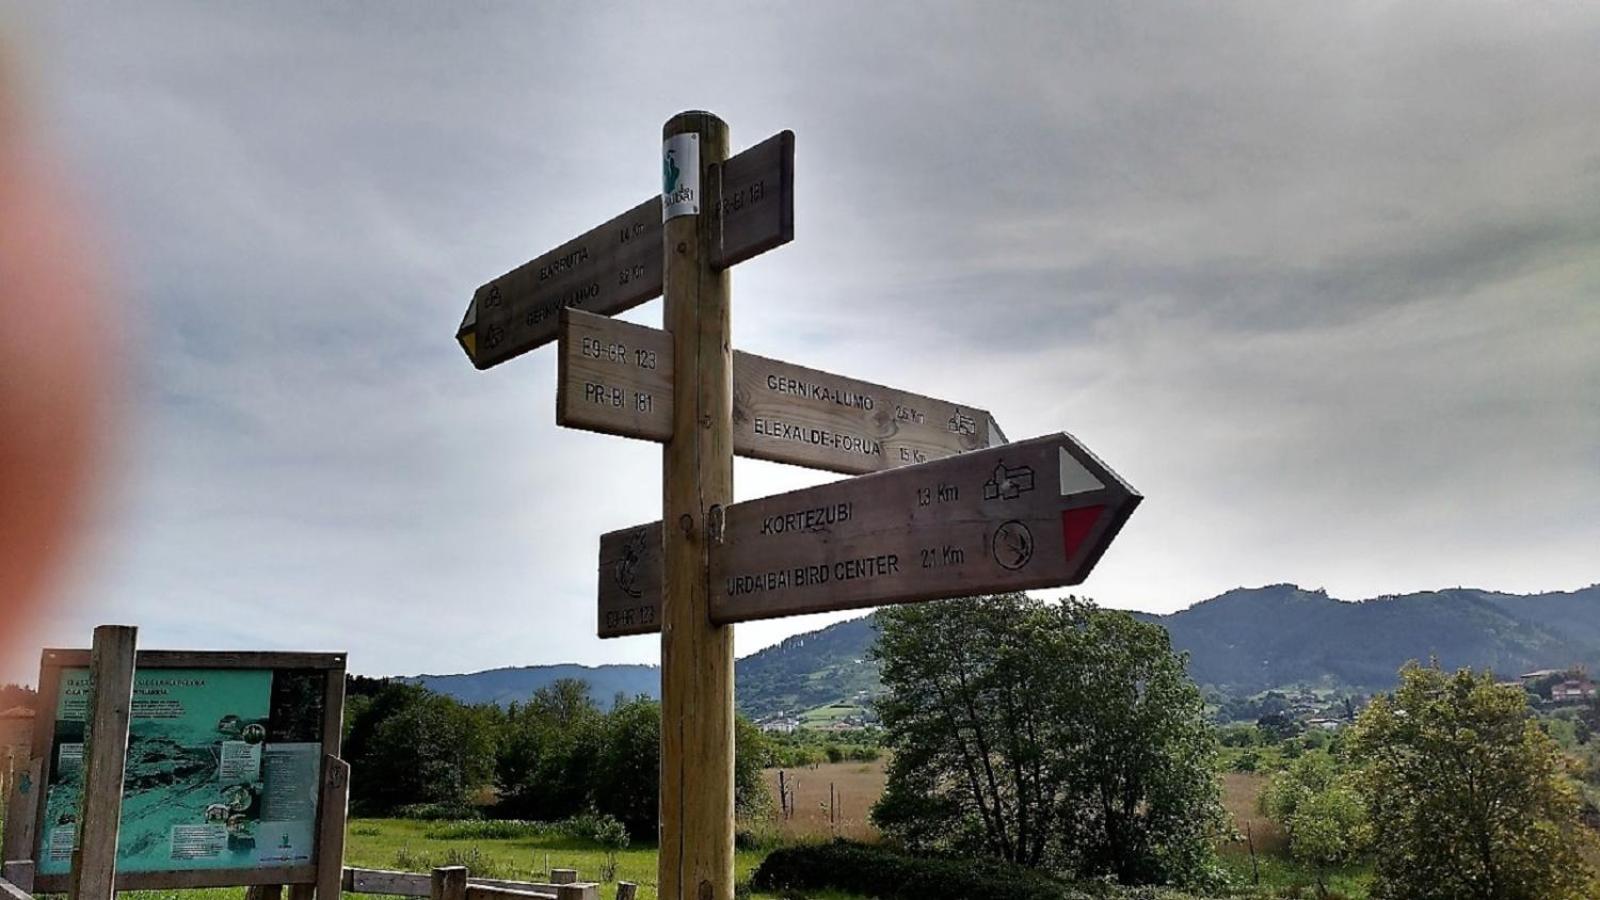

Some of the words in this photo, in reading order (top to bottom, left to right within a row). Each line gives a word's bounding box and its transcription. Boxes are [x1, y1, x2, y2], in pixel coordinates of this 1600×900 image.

[540, 247, 588, 280] BARRUTIA
[582, 337, 626, 364] E9-GR
[635, 348, 656, 370] 123
[585, 382, 625, 408] PR-BI
[634, 392, 652, 413] 181
[767, 374, 874, 411] GERNIKA-LUMO
[754, 418, 881, 456] ELEXALDE-FORUA
[763, 501, 853, 536] KORTEZUBI
[937, 483, 959, 504] Km
[727, 571, 791, 597] URDAIBAI
[795, 563, 830, 587] BIRD
[834, 554, 900, 582] CENTER
[942, 544, 964, 566] Km
